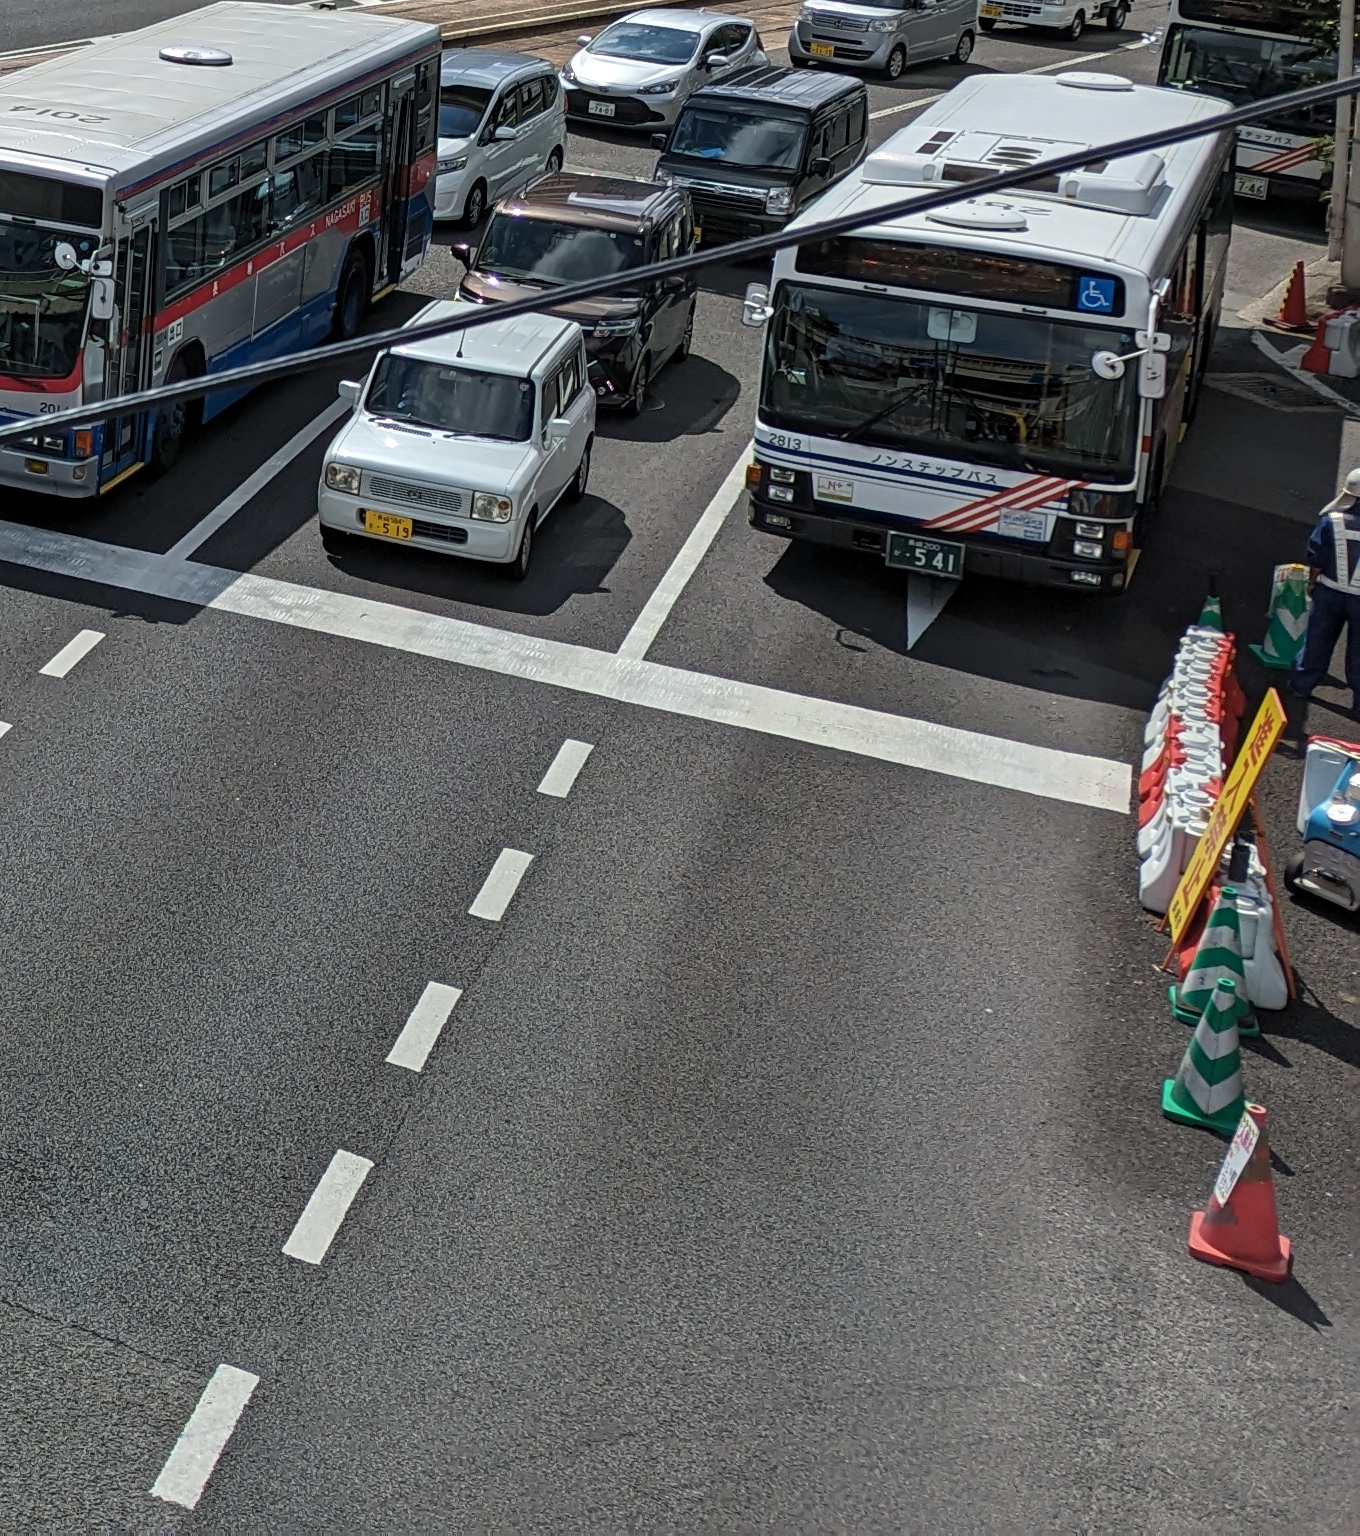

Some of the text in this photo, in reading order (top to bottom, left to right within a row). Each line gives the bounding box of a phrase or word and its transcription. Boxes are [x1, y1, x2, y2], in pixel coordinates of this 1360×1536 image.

[8, 104, 112, 125] 2014
[358, 190, 373, 208] BUS
[325, 199, 357, 228] NAGASAKI
[768, 433, 802, 450] 2813
[871, 454, 998, 485] ノンステップバス
